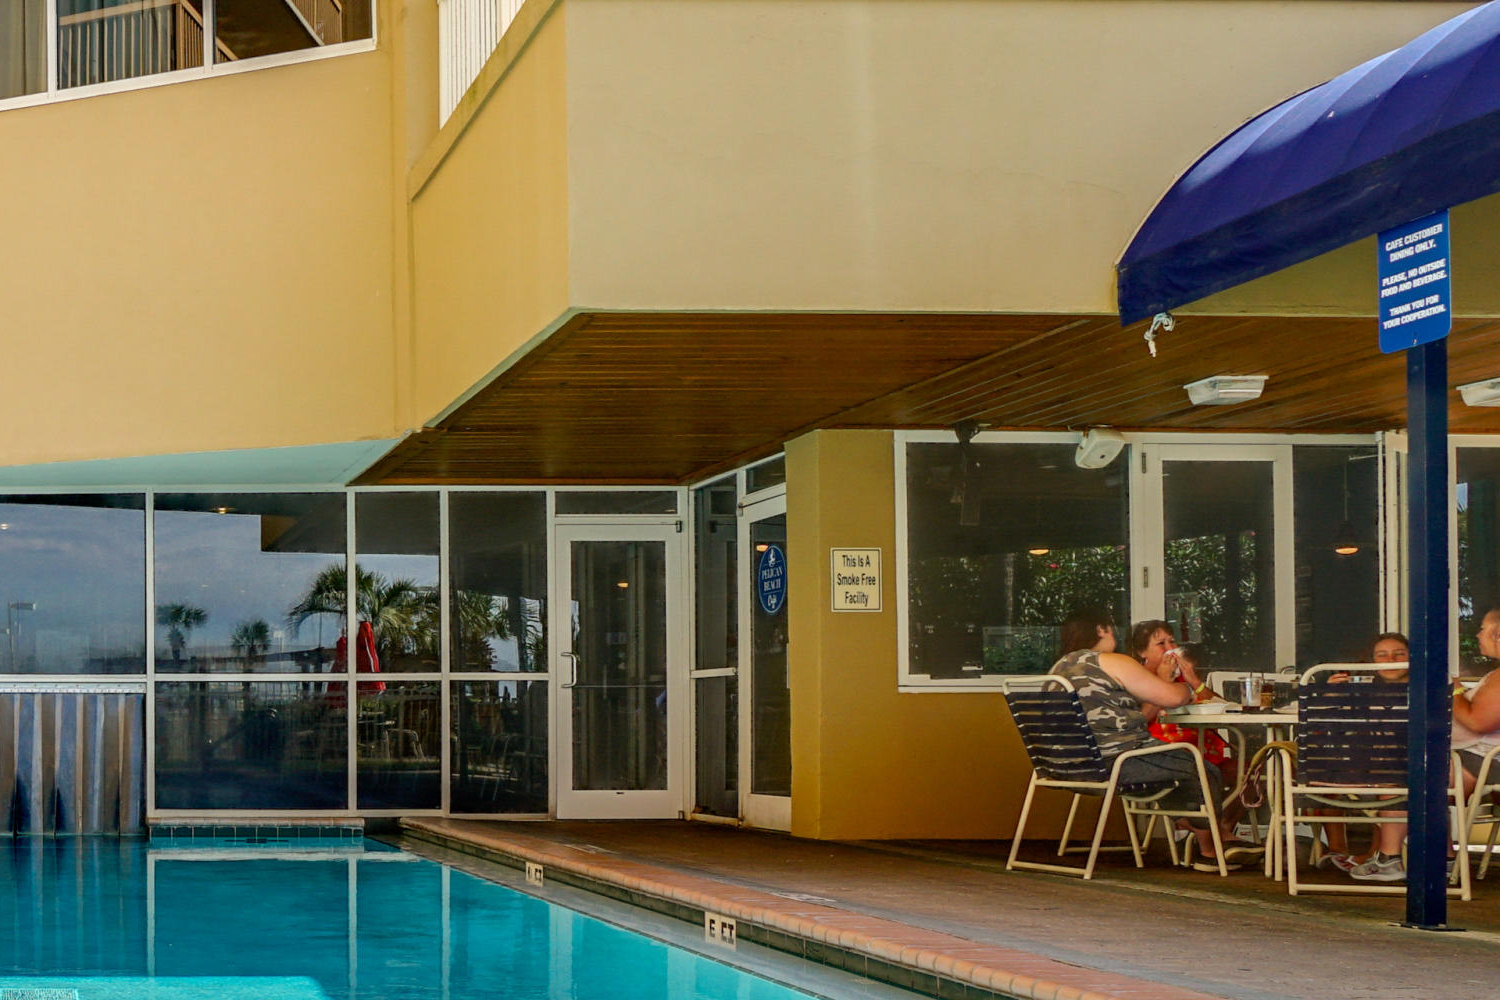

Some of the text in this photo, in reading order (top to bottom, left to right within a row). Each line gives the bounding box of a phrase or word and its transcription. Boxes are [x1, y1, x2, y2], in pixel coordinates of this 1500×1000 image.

[1385, 223, 1443, 252] CAFE CUSTOMER
[1389, 239, 1436, 263] DINING ONLY.
[1380, 270, 1448, 298] FOOD AND BEVERAGE.
[1382, 258, 1446, 287] PLEASE, NO OUTSIDE
[1382, 304, 1447, 330] YOUR COOPERATION.
[1389, 294, 1440, 317] THANK YOU FOR
[842, 554, 871, 568] This Is A
[762, 566, 782, 580] PELICAN
[837, 573, 876, 586] Smoke Free
[845, 591, 869, 607] Facility
